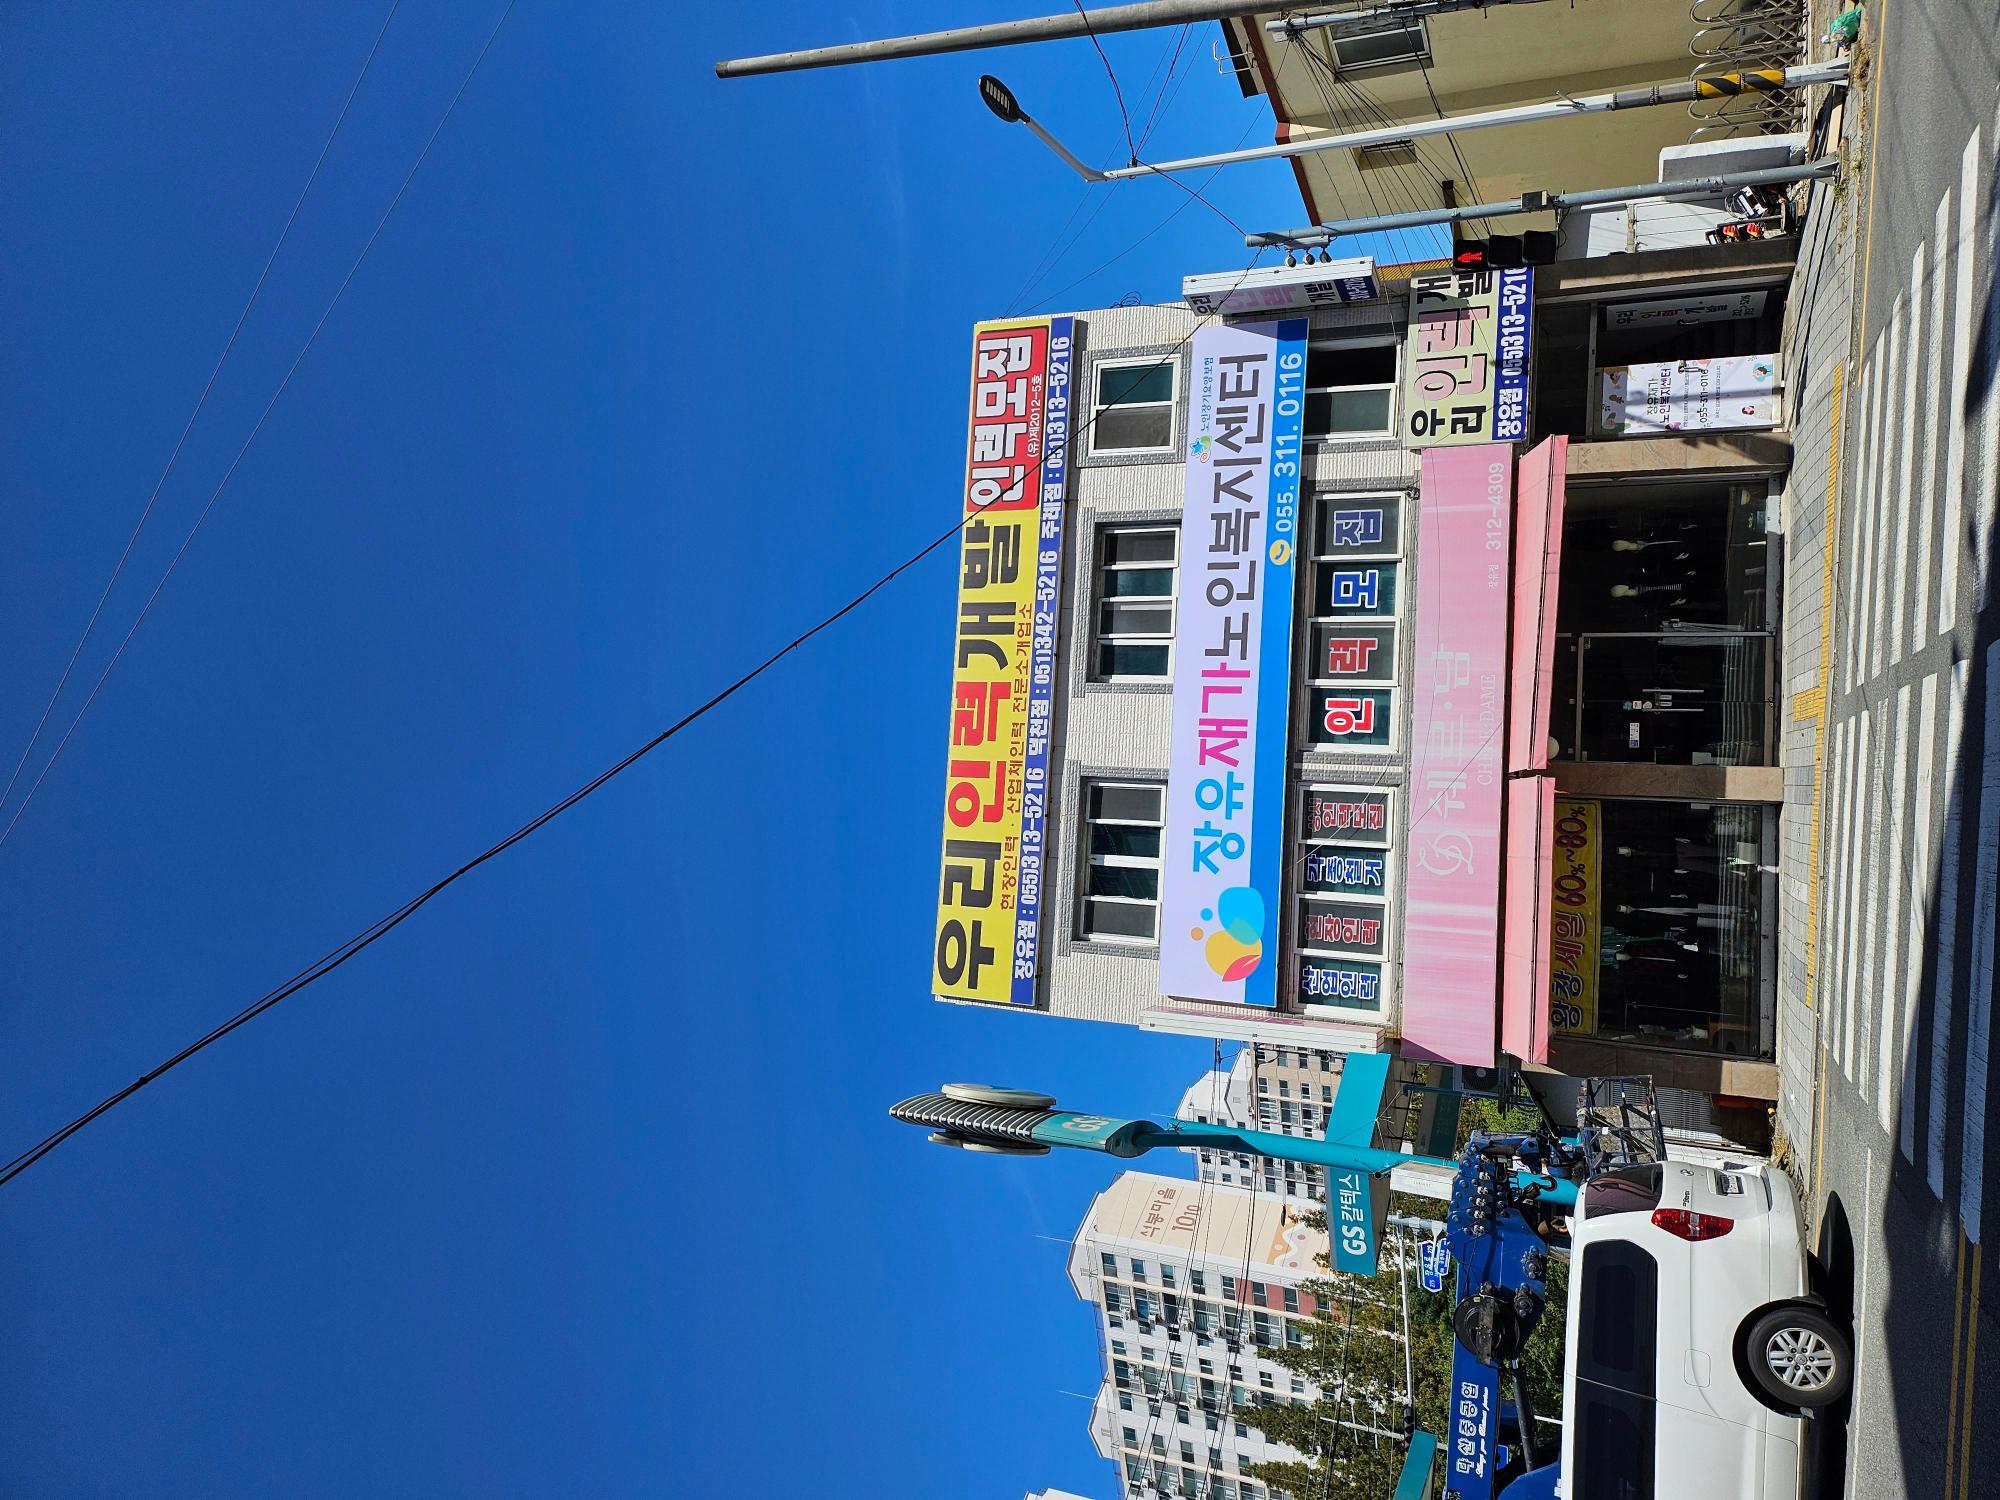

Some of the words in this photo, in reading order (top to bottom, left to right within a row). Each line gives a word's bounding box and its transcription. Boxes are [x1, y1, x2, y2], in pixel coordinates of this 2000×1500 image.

[1277, 352, 1302, 416] 0116
[1413, 305, 1490, 401] 인력
[969, 336, 1032, 506] 인력모집
[1027, 374, 1043, 457] (유)제2012-5호
[1199, 357, 1215, 431] 노인장기요양보험
[1410, 405, 1487, 437] 우리
[1660, 368, 1672, 423] 노인복지센터
[1486, 463, 1505, 550] 312-4309
[1020, 767, 1044, 905] 055)313-5216
[1034, 550, 1058, 684] 051)342-5216
[1047, 336, 1071, 468] 051)313-5216
[1192, 353, 1268, 875] 장유재가노인복지센터
[1012, 603, 1032, 712] 전문소개업소
[937, 519, 1022, 989] 우리인력개발
[1007, 722, 1026, 814] 산업체인력
[1000, 836, 1019, 910] 현장인력
[1306, 854, 1383, 886] 각종철거
[1304, 913, 1381, 945] 현장인력
[1302, 965, 1378, 1000] 산업인력
[1139, 1187, 1176, 1237] 석봉마을
[1338, 1174, 1364, 1222] 칼텍스
[1342, 1225, 1367, 1255] GS
